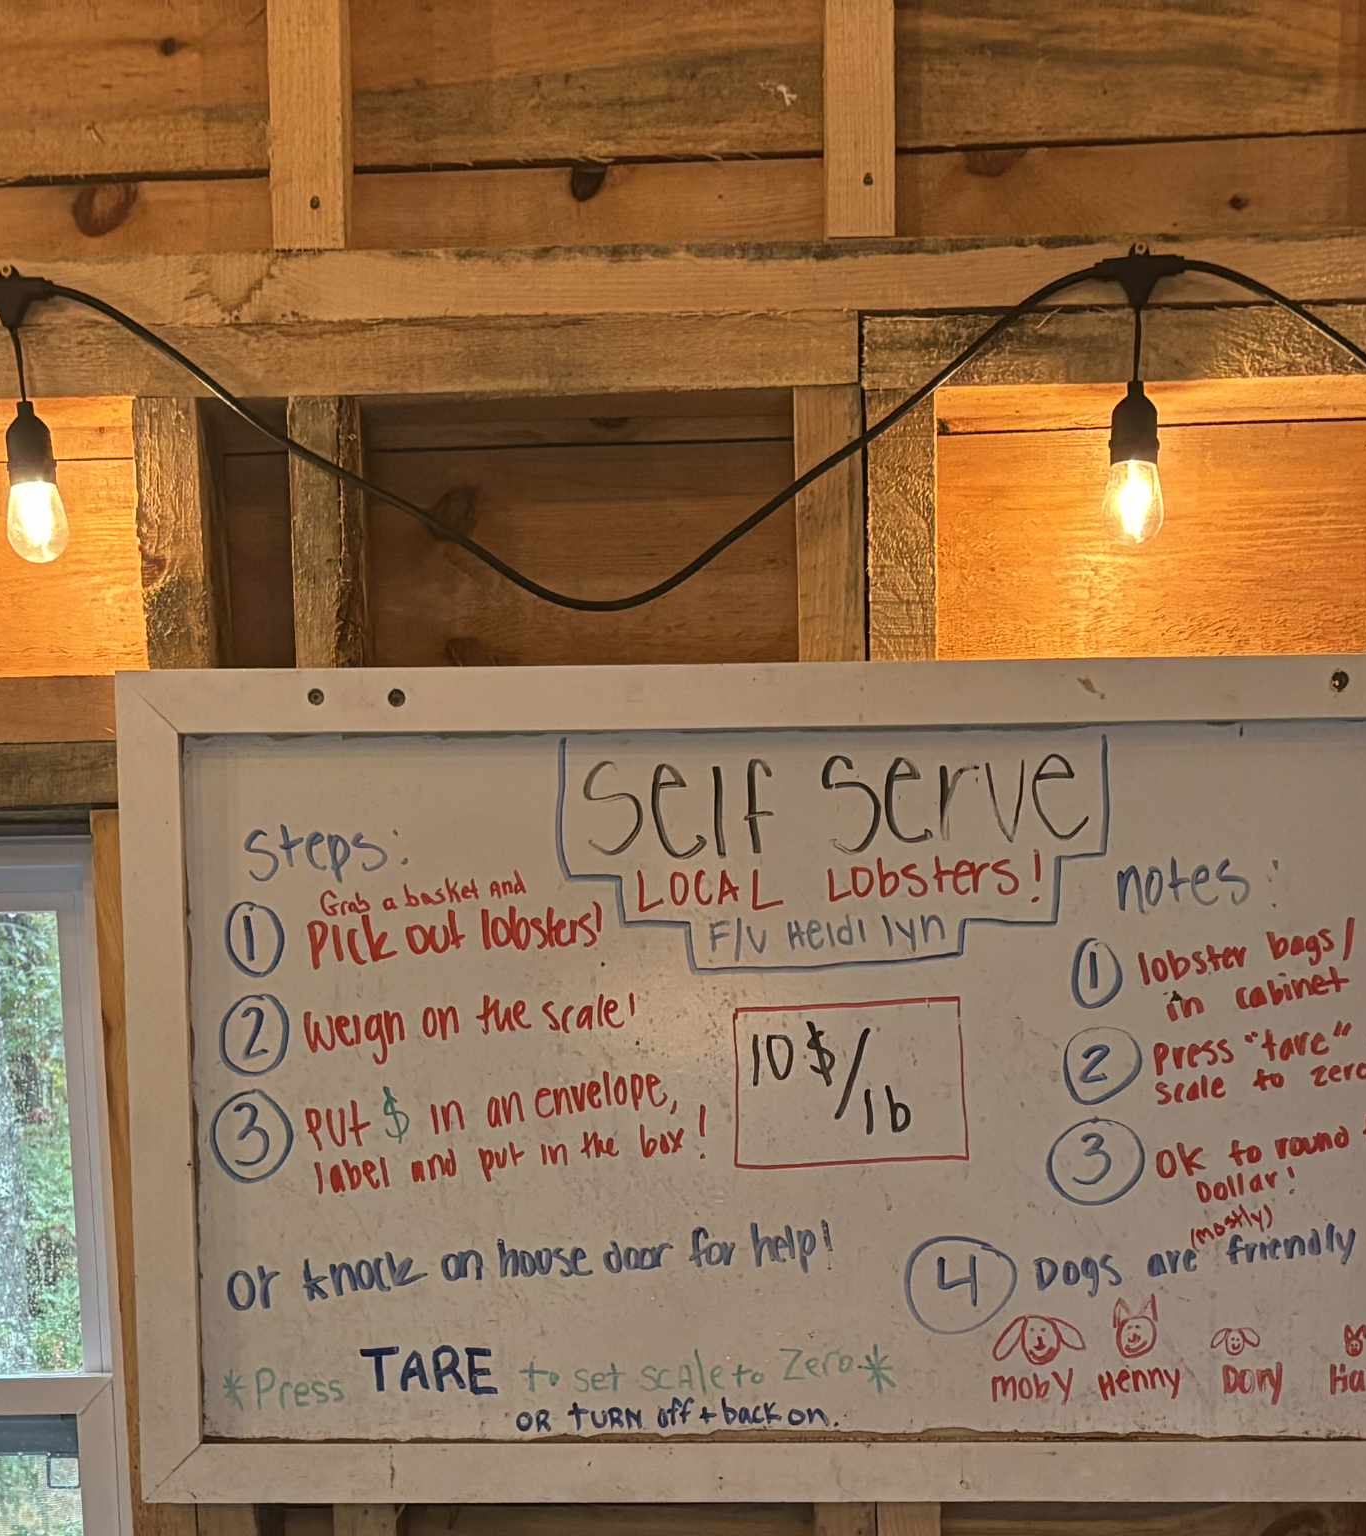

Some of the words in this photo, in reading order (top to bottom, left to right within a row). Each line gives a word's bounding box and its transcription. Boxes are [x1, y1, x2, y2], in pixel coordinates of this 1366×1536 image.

[583, 758, 773, 858] Self
[822, 753, 1090, 853] Serve
[321, 890, 370, 916] Grab
[383, 895, 397, 909] a
[403, 878, 478, 907] basket
[637, 869, 784, 912] LOCAL
[406, 910, 465, 954] out
[481, 902, 603, 950] lobsters!
[1138, 944, 1247, 985] lobster
[1164, 991, 1204, 1022] in
[1235, 966, 1350, 1009] cabinet
[423, 1006, 459, 1040] on
[1155, 1076, 1226, 1104] scale
[1253, 1068, 1284, 1090] to
[384, 1086, 409, 1143] $
[430, 1099, 464, 1134] in
[486, 1091, 525, 1128] an
[315, 1157, 389, 1194] label
[411, 1153, 458, 1183] and
[478, 1147, 525, 1181] put
[541, 1139, 567, 1166] in
[581, 1131, 619, 1159] the
[1229, 1139, 1263, 1166] to
[1274, 1126, 1349, 1160] round
[441, 1249, 483, 1281] on
[497, 1238, 592, 1278] house
[603, 1241, 673, 1273] door
[690, 1226, 736, 1267] for
[750, 1219, 834, 1272] help!
[1035, 1254, 1122, 1296] Dogs
[1147, 1248, 1197, 1278] are
[1226, 1223, 1355, 1264] friendly
[360, 1345, 498, 1395] TARE
[518, 1362, 559, 1390] to
[574, 1363, 624, 1391] set
[734, 1366, 763, 1386] to
[1098, 1366, 1182, 1400] Henny
[656, 1397, 696, 1427] off
[723, 1398, 781, 1424] back
